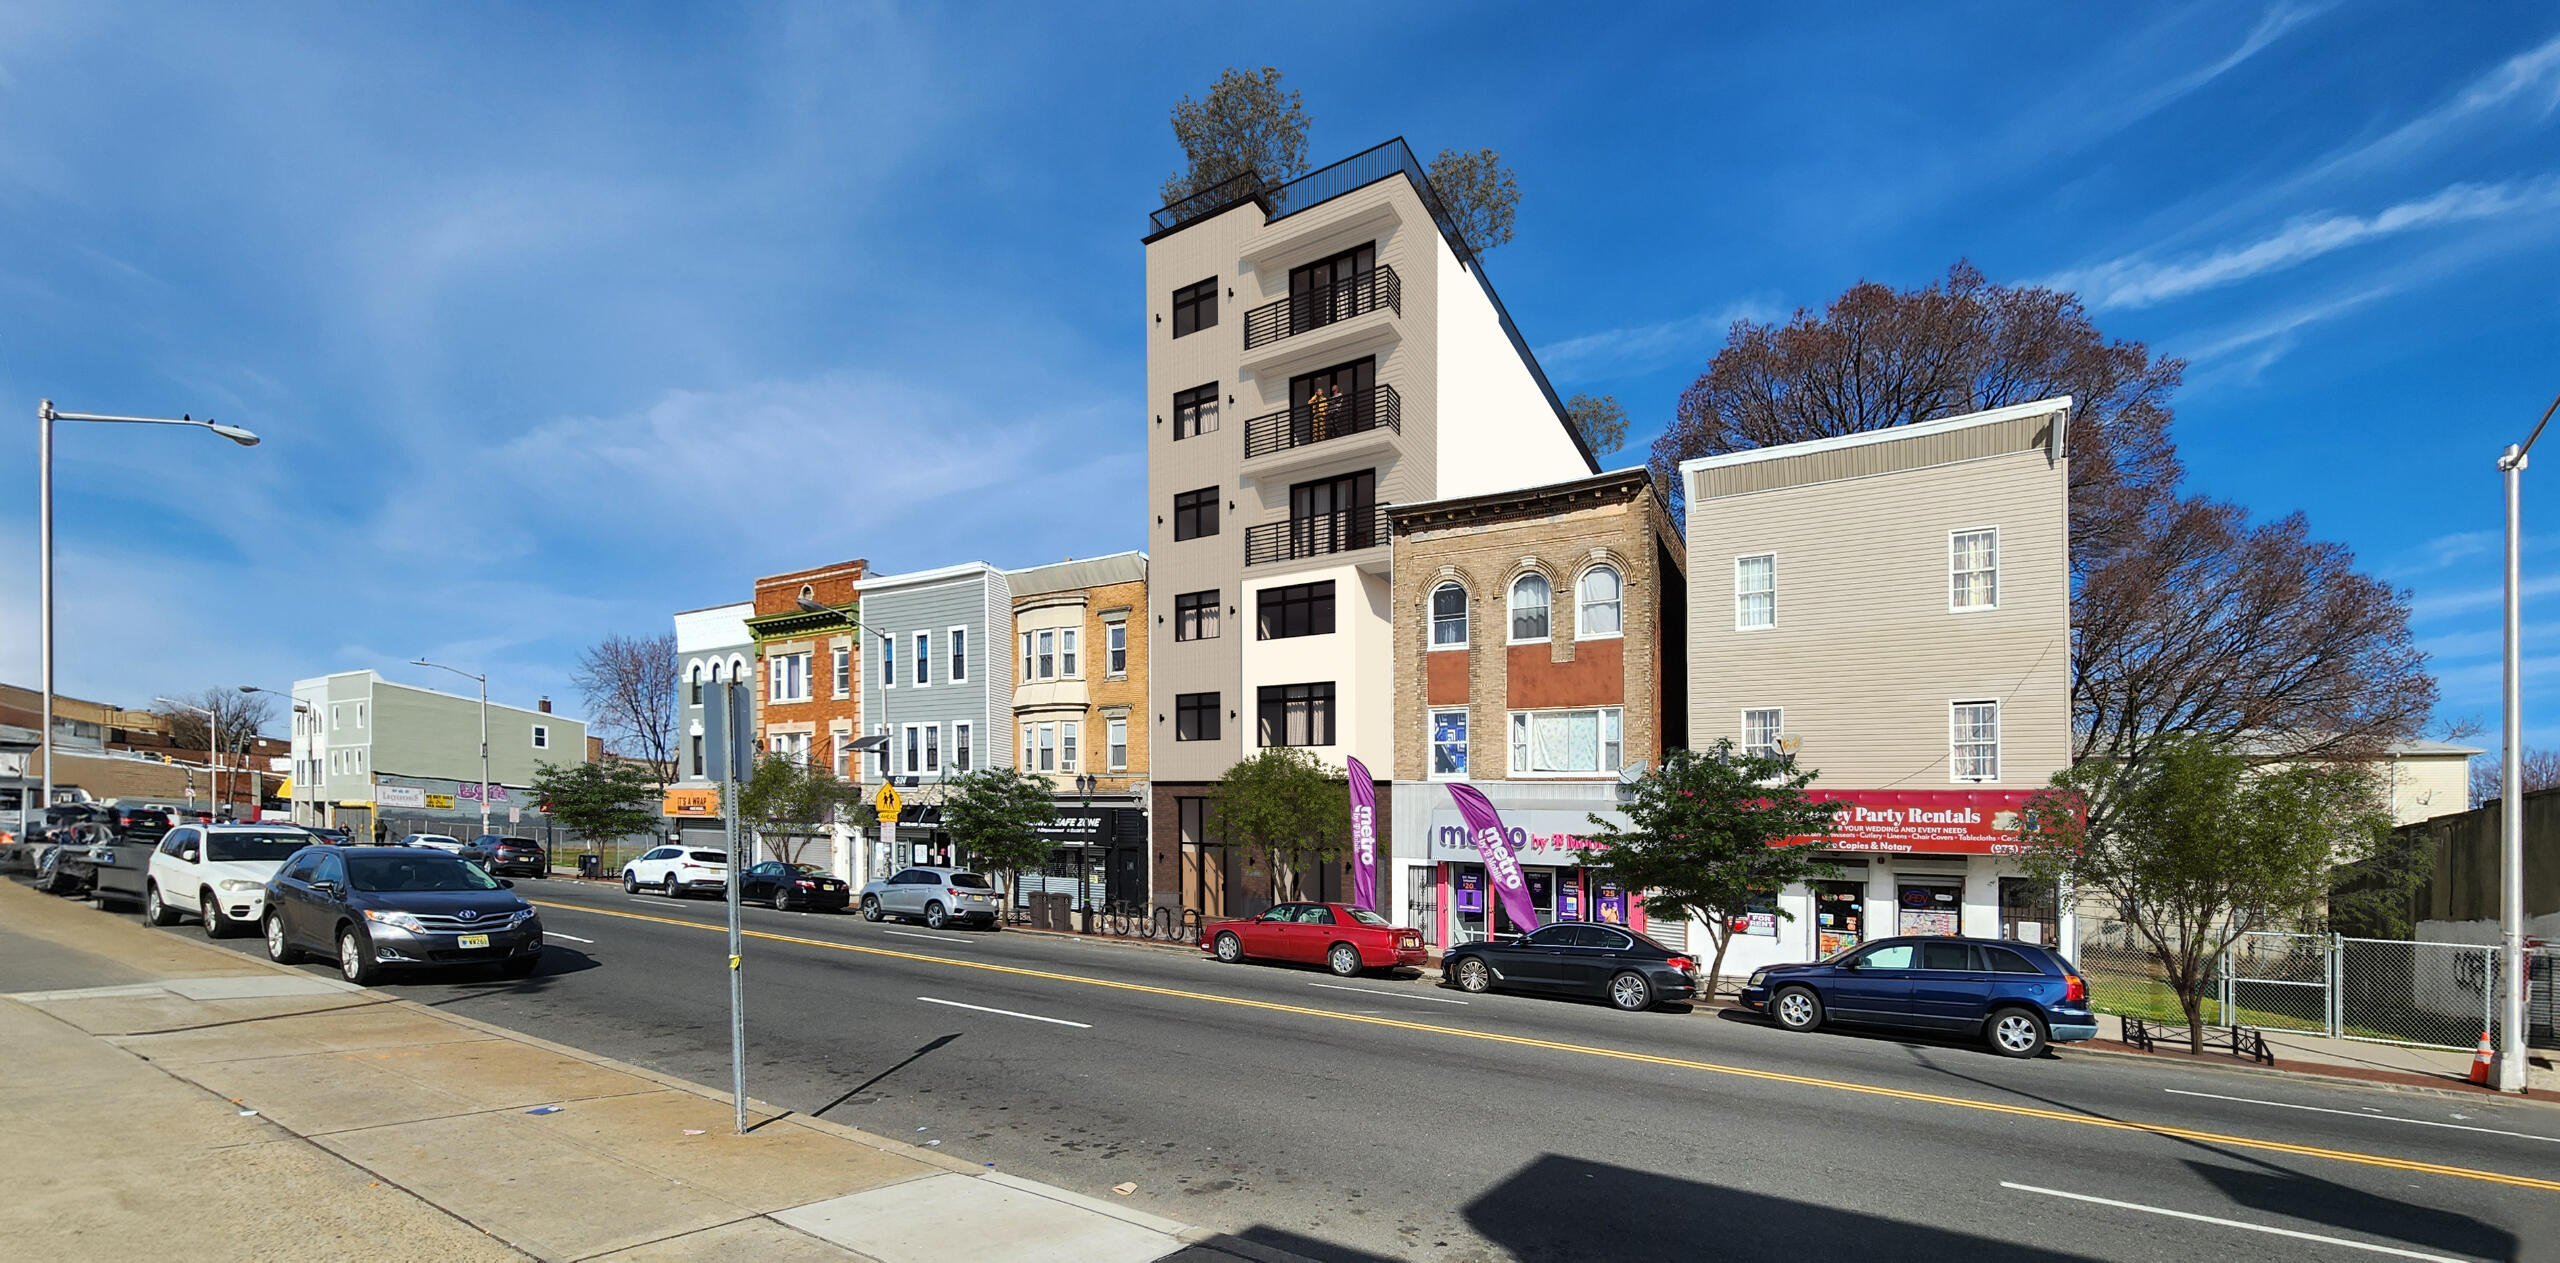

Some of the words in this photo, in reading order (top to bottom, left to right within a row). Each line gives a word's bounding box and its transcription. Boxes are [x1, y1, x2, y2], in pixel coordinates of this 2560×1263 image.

[1054, 817, 1077, 827] SAFE
[1855, 806, 1905, 826] Party
[1908, 807, 1981, 824] Rentals
[1360, 805, 1375, 866] metro
[1859, 832, 1883, 840] Cutlery
[1959, 834, 1996, 842] Tablecloths
[1839, 840, 1869, 851] Copies
[1870, 841, 1879, 850] &
[1880, 842, 1912, 853] Notary
[1485, 826, 1522, 889] metro
